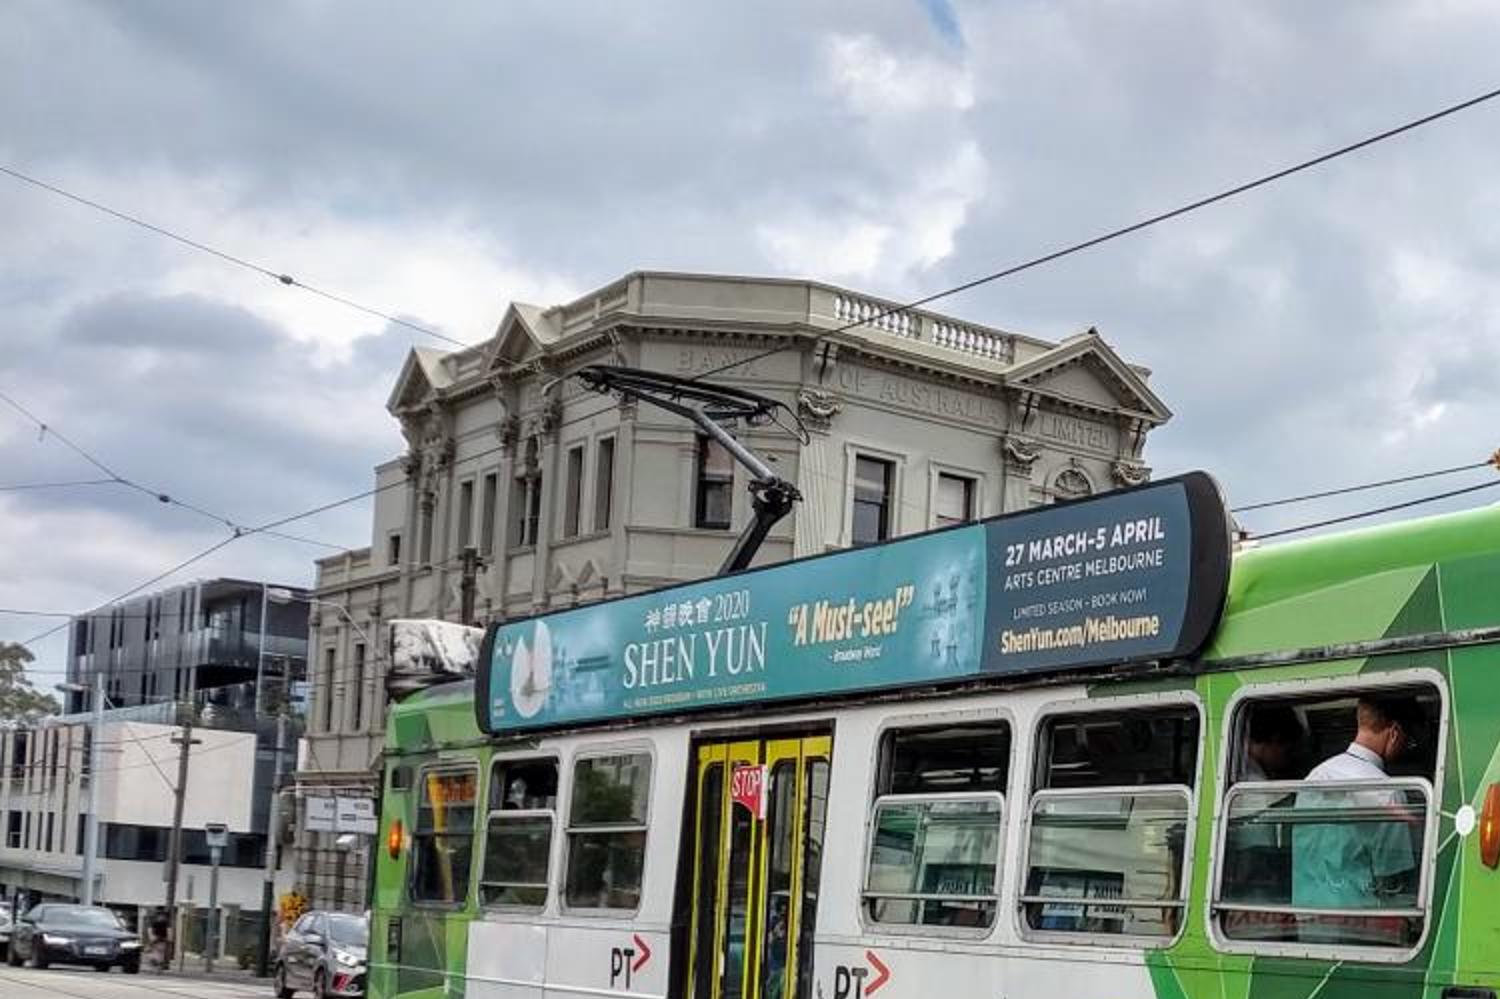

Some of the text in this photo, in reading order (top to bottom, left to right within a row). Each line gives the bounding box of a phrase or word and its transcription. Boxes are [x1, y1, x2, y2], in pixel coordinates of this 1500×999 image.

[1005, 516, 1165, 567] 27 MARCH-5 APRIL
[1004, 549, 1163, 592] ARTS CENTRE MELBOURNE
[714, 590, 750, 622] 2020
[1013, 605, 1047, 620] LIMITED
[1047, 598, 1083, 616] SEASON
[1091, 593, 1118, 610] BOOK
[1001, 615, 1160, 654] ShenYun.com/Melbourne
[623, 622, 769, 689] SHEN YUN
[731, 766, 761, 797] STOP
